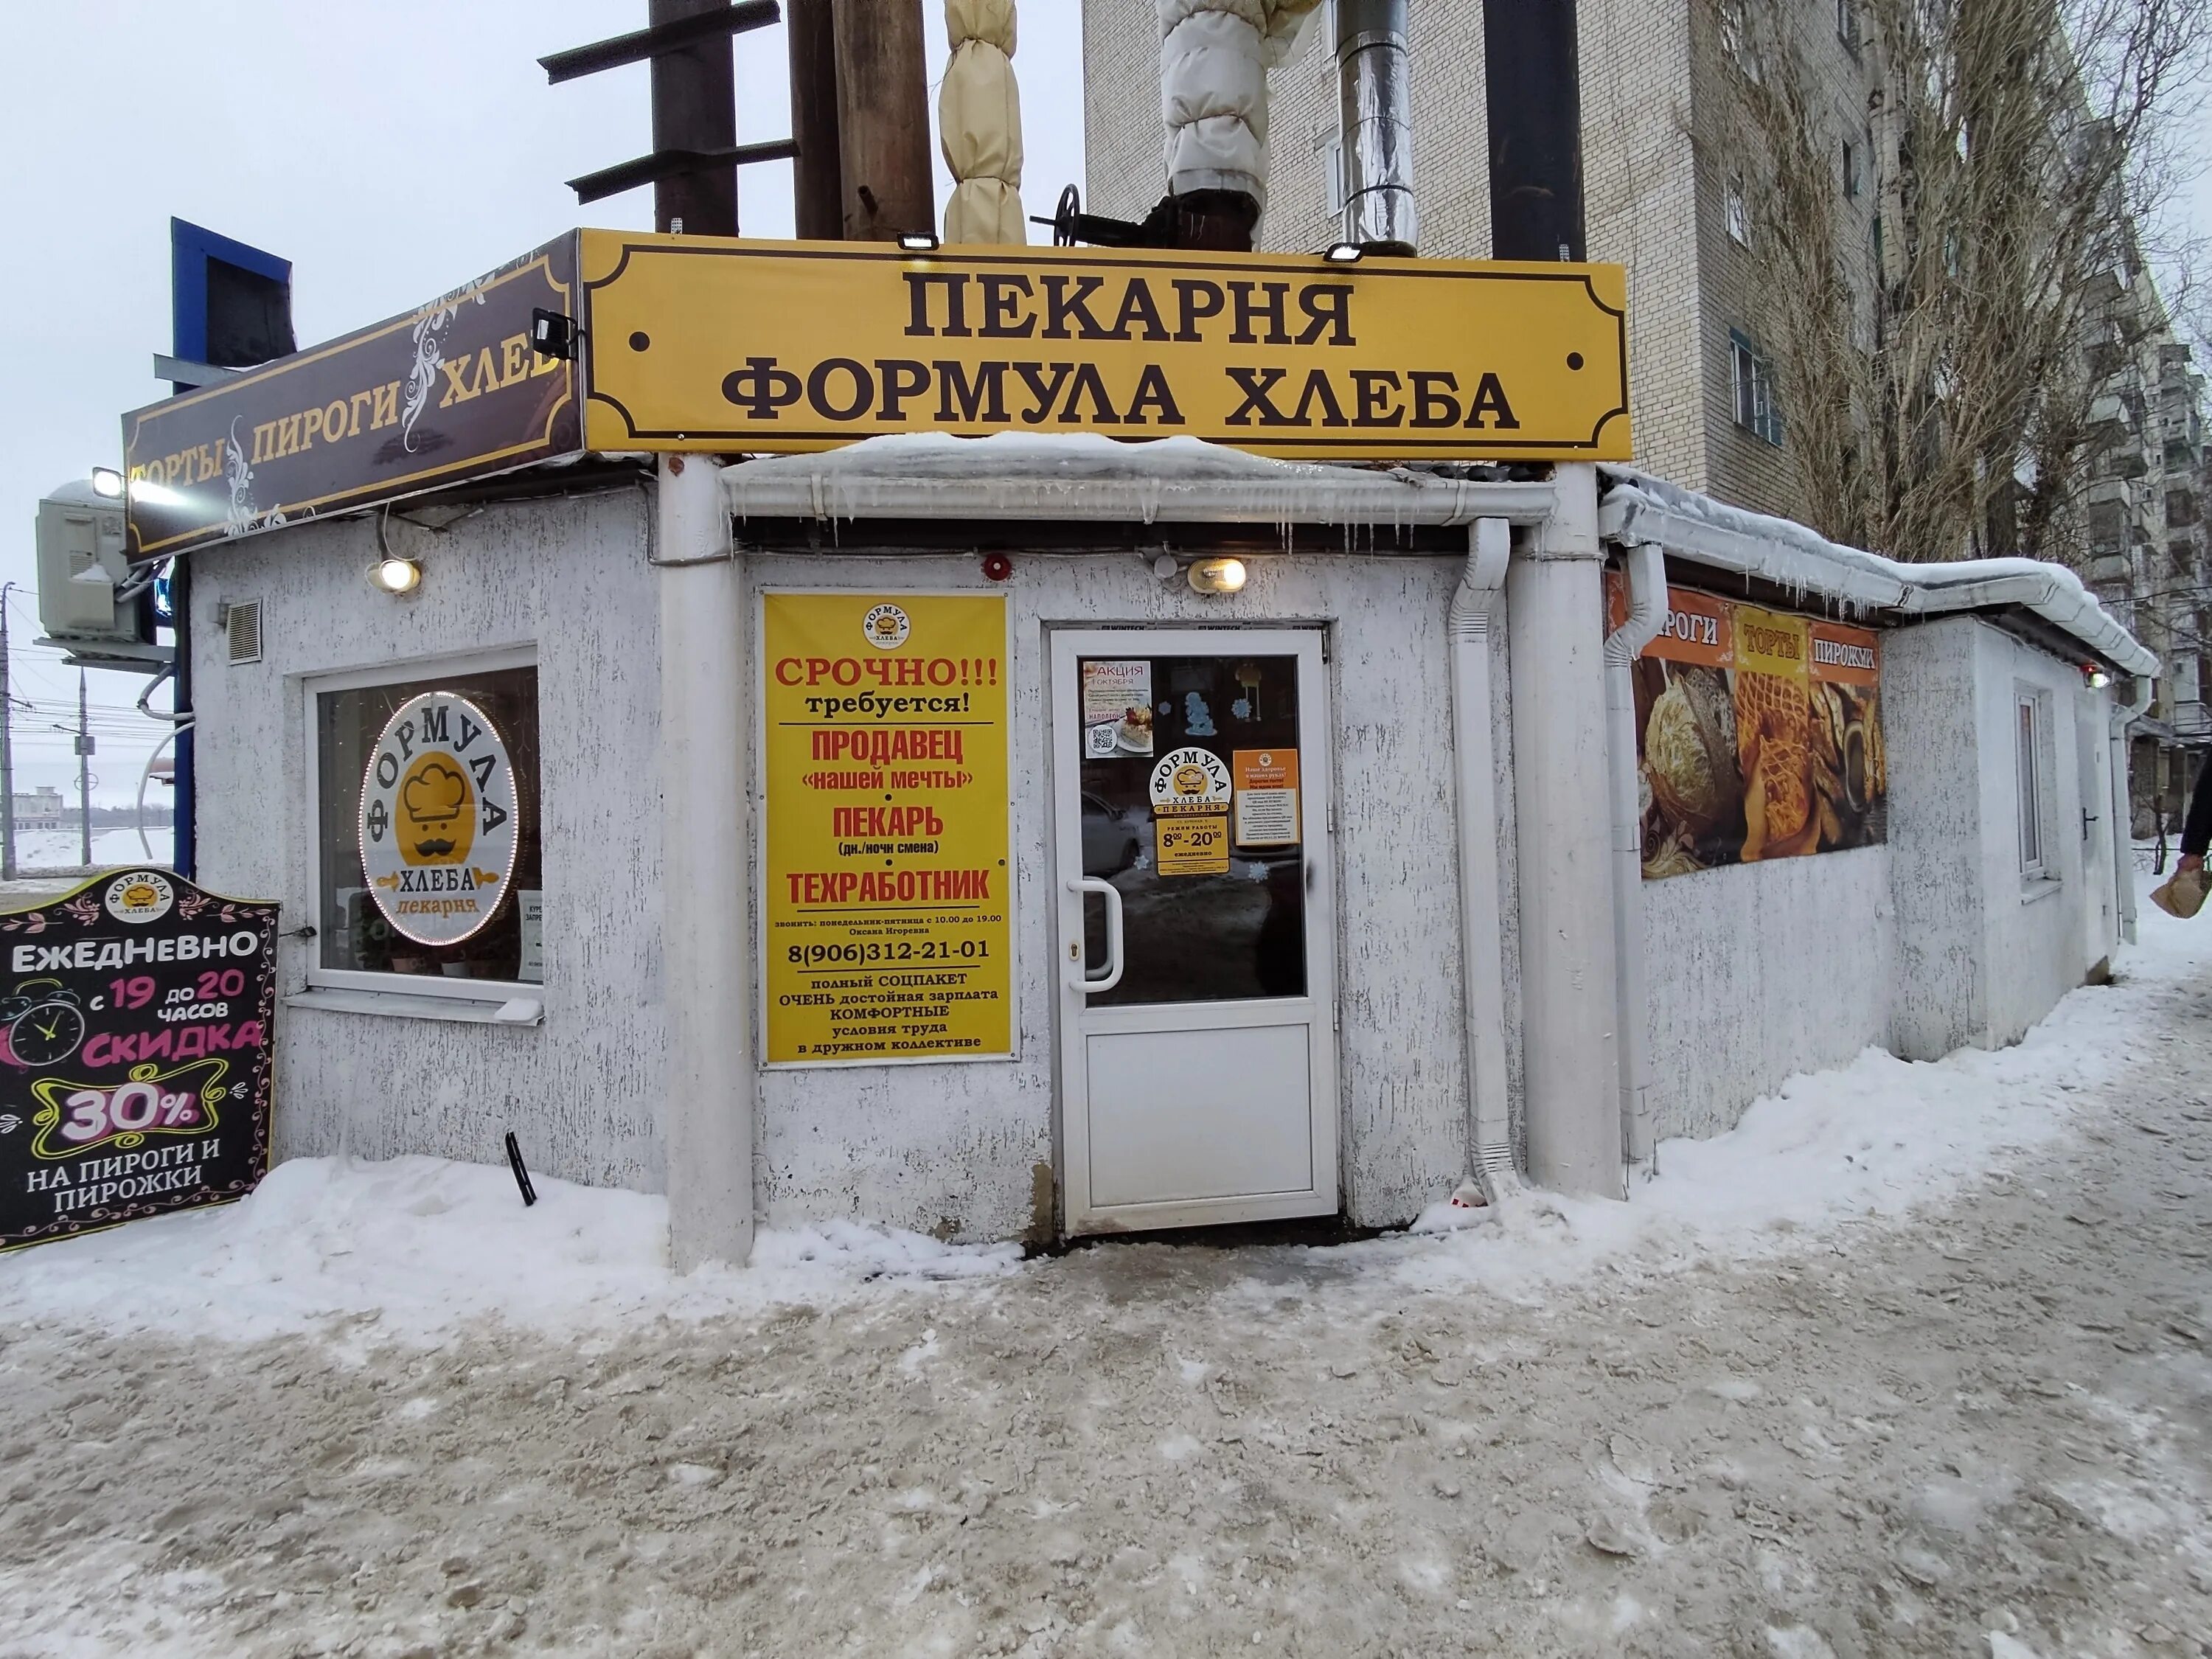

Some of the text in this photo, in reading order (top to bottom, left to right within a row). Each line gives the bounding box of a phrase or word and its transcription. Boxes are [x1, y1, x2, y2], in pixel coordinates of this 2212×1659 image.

[902, 272, 1357, 347] ПЕКАРНЯ
[721, 357, 1520, 429] ФОРМУЛА ХЛЕБА
[251, 380, 402, 465] ПИРОГИ
[866, 606, 908, 630] ФОРМУЛА
[1658, 610, 1718, 645] РОГИ
[1744, 624, 1801, 660] ТОРТЫ
[775, 658, 997, 686] СРОЧНО!!!
[1097, 666, 1144, 678] АКЦИЯ
[804, 690, 970, 718] требуется!
[812, 730, 964, 765] ПРОДАВЕЦ
[367, 706, 507, 843] ФОРМУЛА
[802, 765, 973, 790] «нашей мечты»
[1155, 751, 1227, 793] ФОРМУЛА
[833, 807, 944, 838] ПЕКАРЬ
[1163, 804, 1220, 813] ПЕКАРНЯ
[838, 840, 939, 856] (дн./ночн смена)
[109, 874, 170, 903] ФОРМУЛА
[399, 868, 475, 892] ХЛЕБА
[786, 869, 990, 904] ТЕХРАБОТНИК
[395, 898, 481, 919] пекарня
[774, 920, 817, 928] звонить:
[819, 917, 924, 928] понедельник-пятница
[935, 916, 960, 924] 10.00
[962, 916, 974, 924] до
[849, 926, 930, 936] Оксана Игоревна
[13, 931, 258, 972] ЕЖЕДНЕВНО
[787, 940, 990, 967] 8(906)312-21-01
[110, 976, 156, 1009] 19
[197, 969, 244, 999] 20
[810, 973, 968, 990] полный СОЦПАКЕТ
[157, 1003, 229, 1021] ЧАСОВ
[779, 990, 999, 1006] ОЧЕНЬ достойная зарплата
[830, 1005, 950, 1021] КОМФОРТНЫЕ
[82, 1020, 260, 1068] СКИДКА
[832, 1023, 947, 1040] условия труда
[798, 1037, 981, 1056] в дружном коллективе
[62, 1082, 198, 1141] 30%
[27, 1138, 220, 1192] НА ПИРОГИ И
[54, 1165, 203, 1213] ПИРОЖКИ
